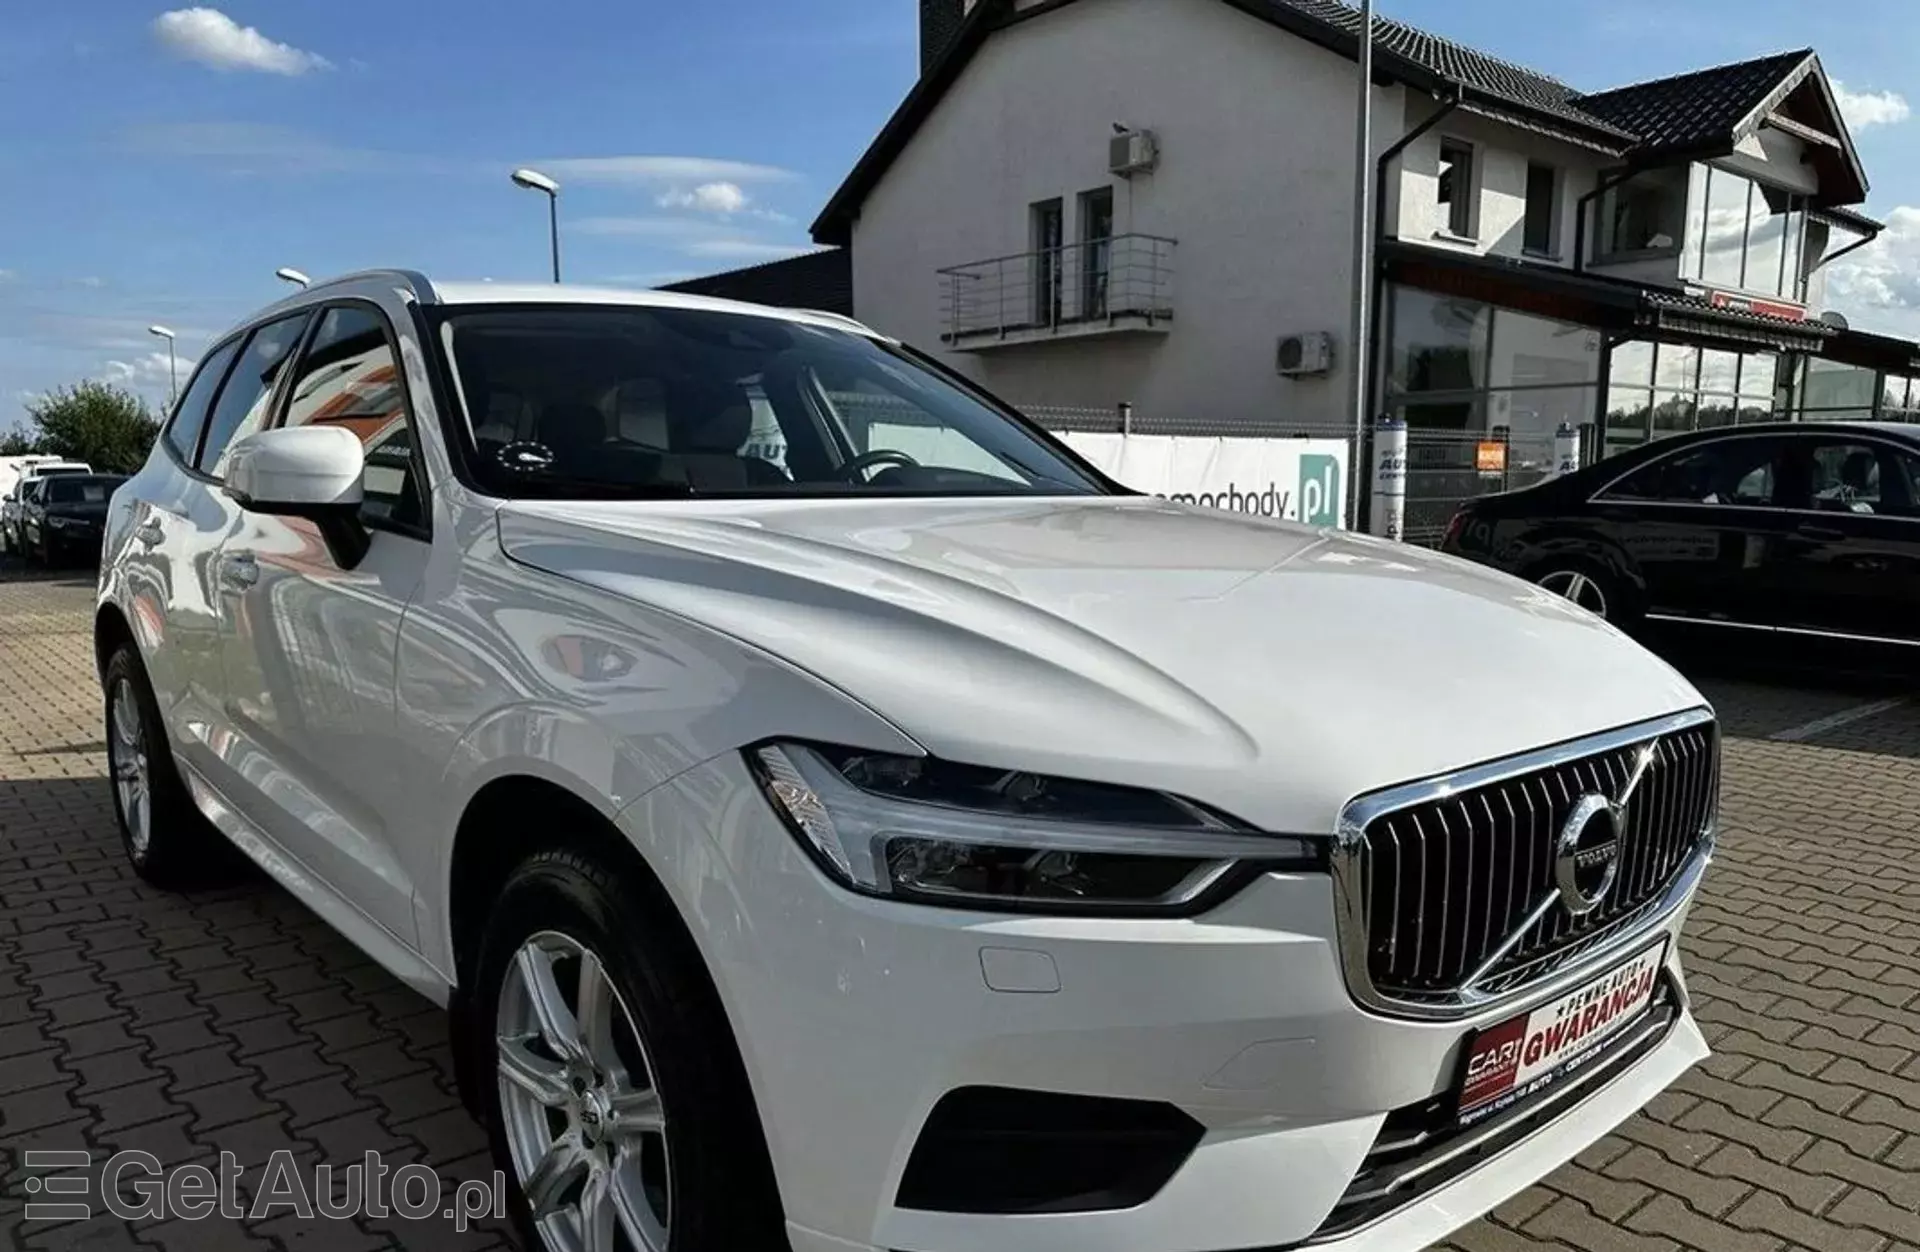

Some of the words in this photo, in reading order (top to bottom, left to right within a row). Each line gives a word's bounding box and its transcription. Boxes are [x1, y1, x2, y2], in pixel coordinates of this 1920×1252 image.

[745, 443, 787, 459] AU
[1155, 465, 1333, 524] ochody.pl
[1524, 966, 1654, 1068] GWARANCJA
